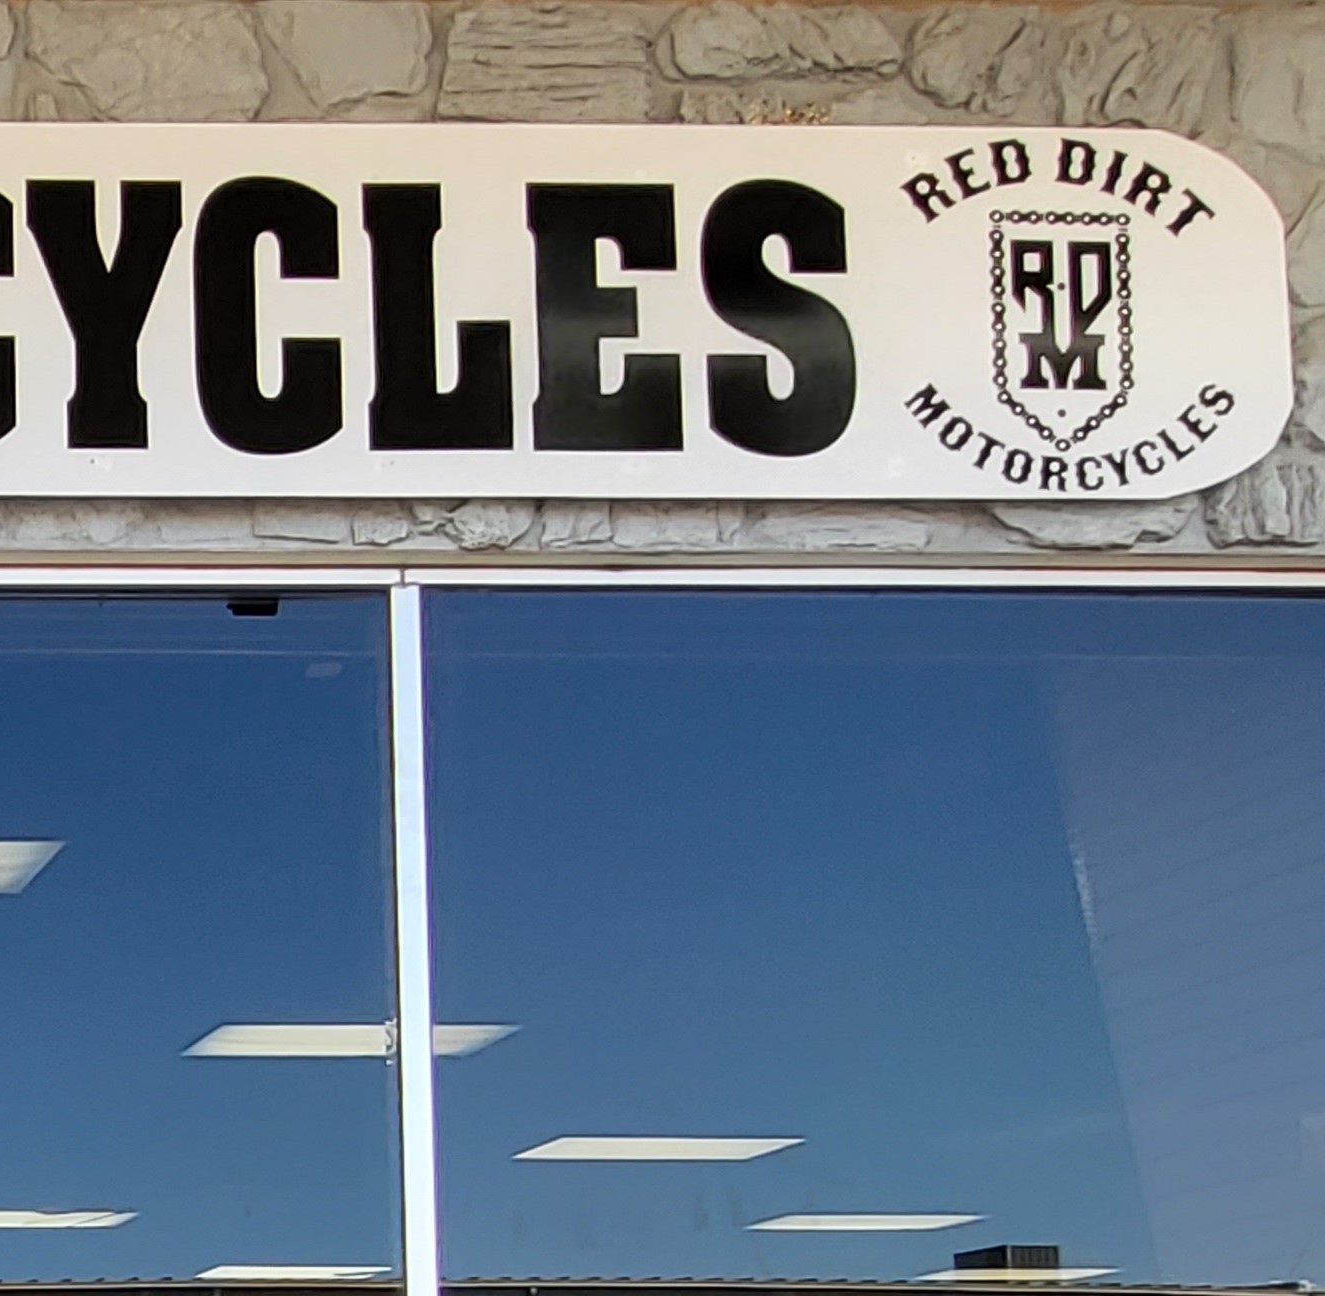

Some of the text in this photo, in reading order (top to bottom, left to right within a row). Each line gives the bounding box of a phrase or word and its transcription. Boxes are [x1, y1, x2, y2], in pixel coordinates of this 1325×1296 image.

[900, 138, 1216, 237] RED DIRT
[904, 382, 1236, 493] MOTORCYCLES
